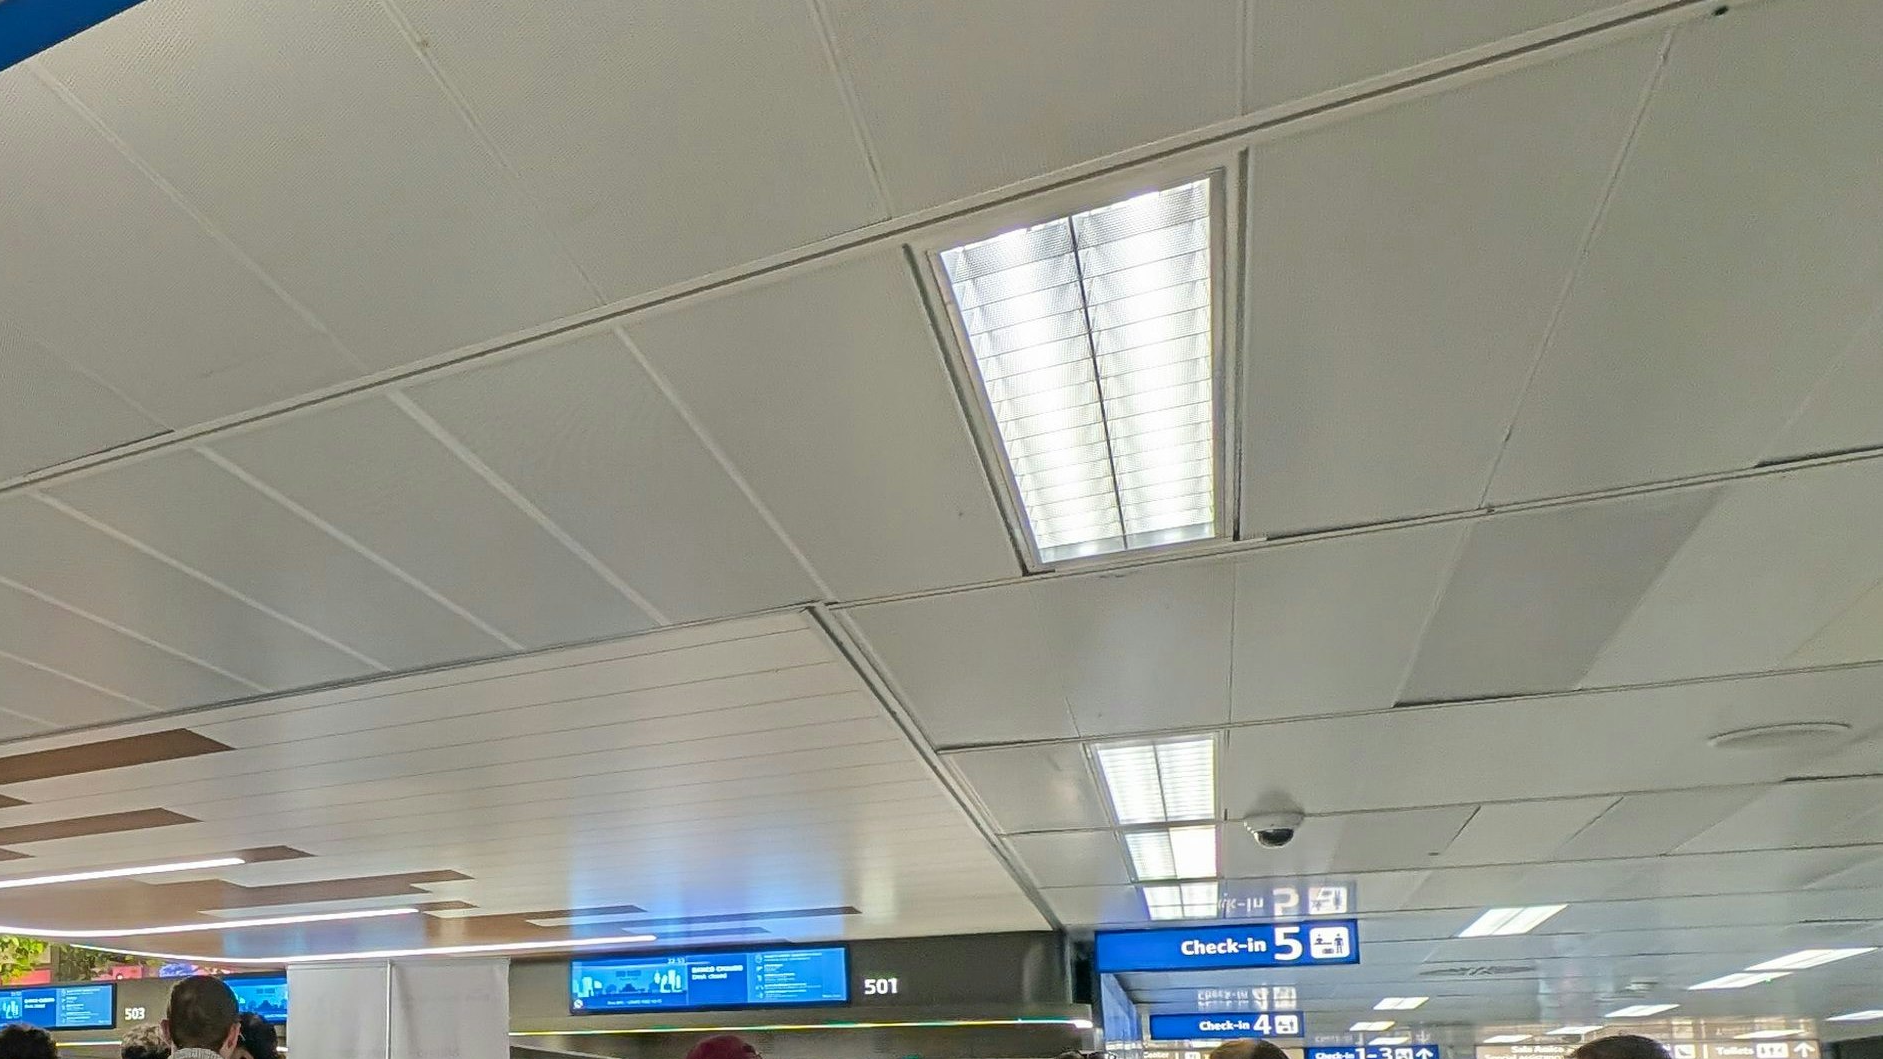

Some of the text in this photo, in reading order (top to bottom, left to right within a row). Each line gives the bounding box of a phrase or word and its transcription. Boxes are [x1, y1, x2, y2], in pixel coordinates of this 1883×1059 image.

[1180, 926, 1303, 961] Check-in 5
[863, 978, 899, 995] 501
[124, 1007, 146, 1020] 503
[1199, 1013, 1272, 1035] Check-in 4
